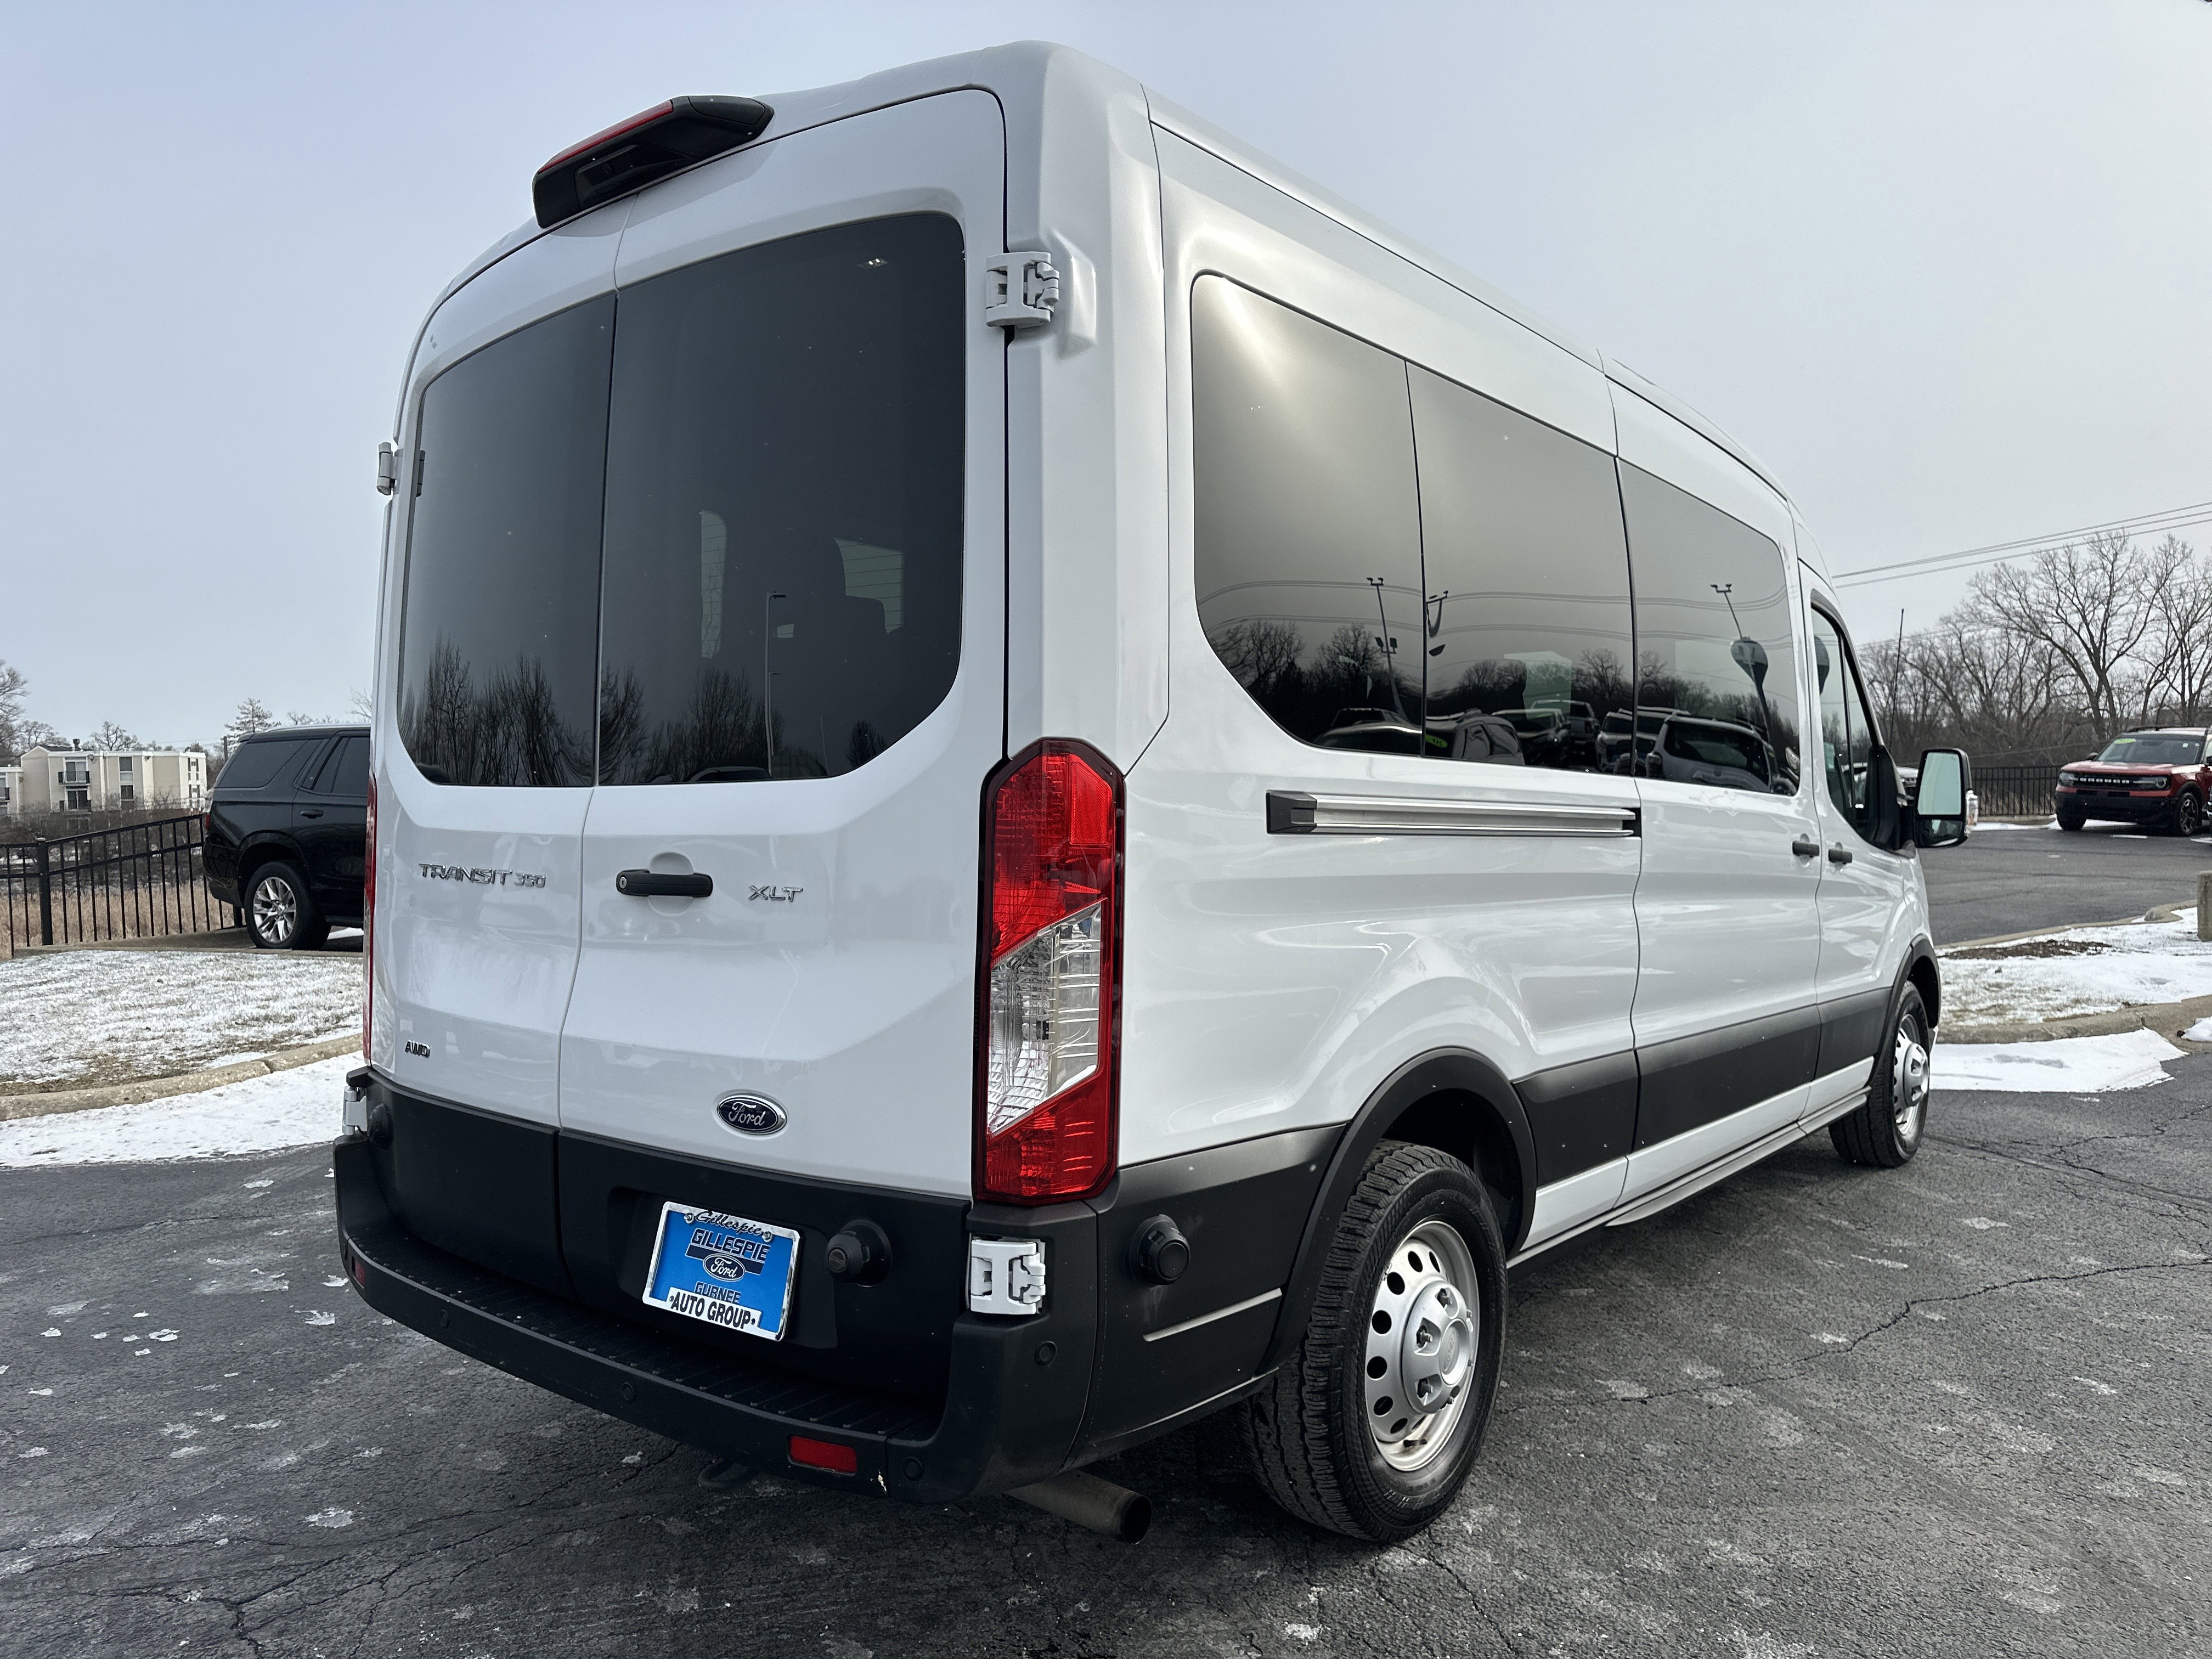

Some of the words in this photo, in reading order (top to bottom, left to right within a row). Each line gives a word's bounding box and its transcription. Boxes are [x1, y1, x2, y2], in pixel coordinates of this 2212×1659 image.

[419, 863, 513, 885] TRANSIT
[514, 872, 546, 888] 350
[748, 884, 804, 902] XLT
[405, 1040, 431, 1058] AWD
[728, 1101, 766, 1126] Ford
[695, 1210, 763, 1235] Gillespie
[690, 1228, 771, 1262] GILLESPIE
[710, 1257, 738, 1278] Ford
[693, 1281, 742, 1304] GURNEE
[670, 1291, 705, 1317] AUTO
[707, 1301, 752, 1329] GROUP
